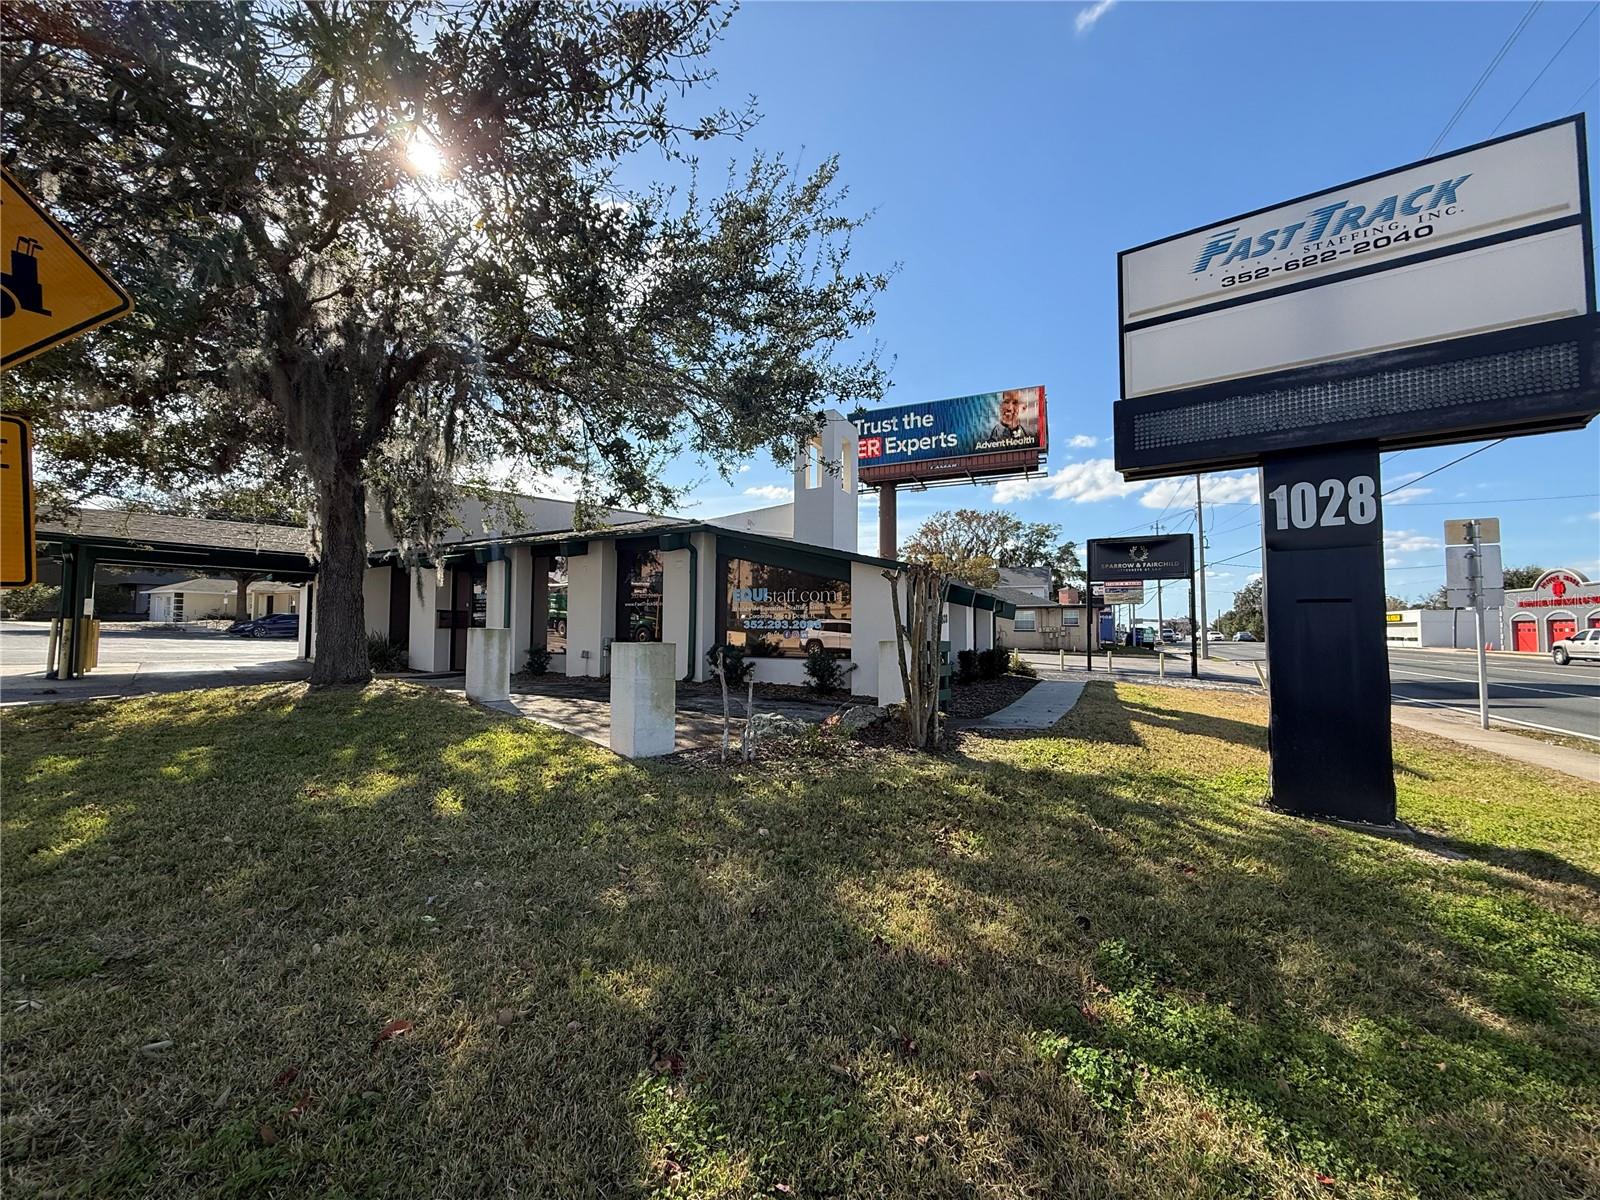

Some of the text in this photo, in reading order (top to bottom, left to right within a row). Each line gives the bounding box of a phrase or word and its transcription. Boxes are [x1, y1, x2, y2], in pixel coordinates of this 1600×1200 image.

[1302, 206, 1465, 254] STAFFING, INC.
[1221, 224, 1434, 288] 352-622-2040
[853, 412, 934, 435] Trust the
[858, 431, 958, 458] ER Experts
[1268, 475, 1377, 530] 1028
[1143, 561, 1180, 569] FAIRCHILD
[733, 588, 837, 603] EQUIstaff.com
